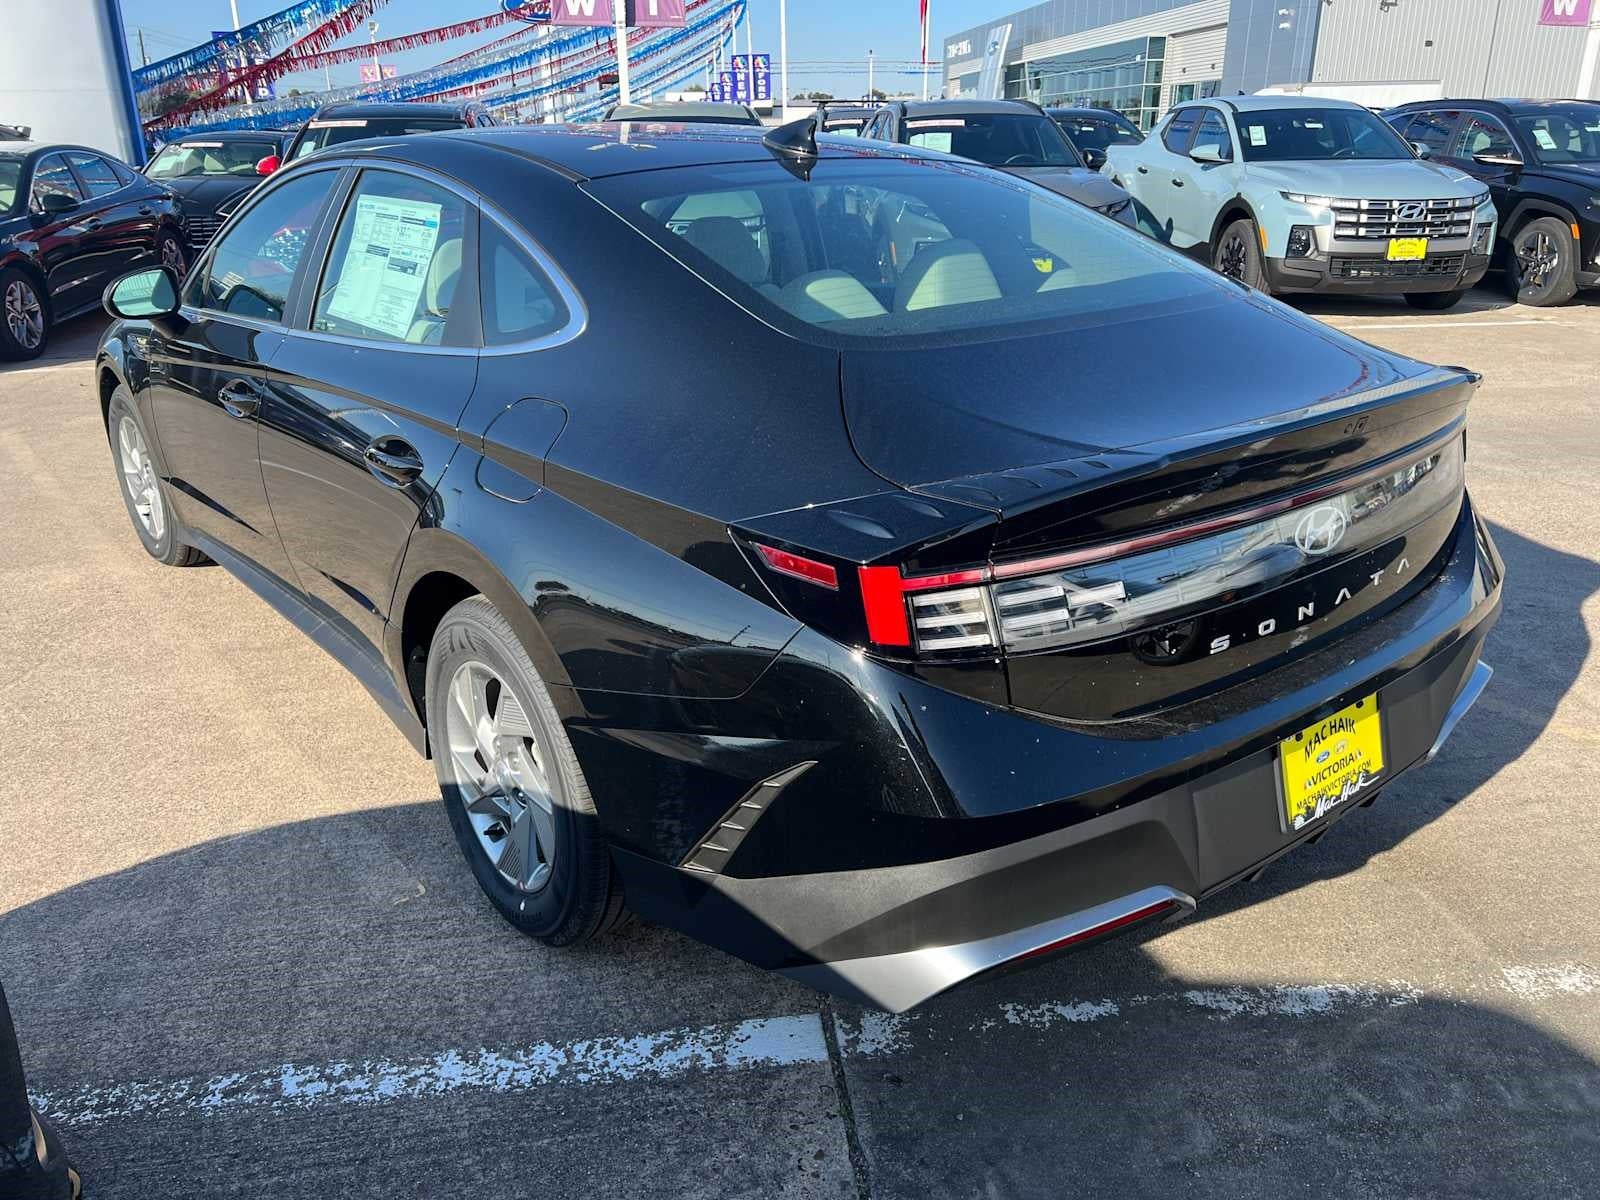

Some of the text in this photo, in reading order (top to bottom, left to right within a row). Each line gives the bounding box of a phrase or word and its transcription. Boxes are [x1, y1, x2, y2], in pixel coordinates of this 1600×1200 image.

[736, 72, 747, 99] NEW
[757, 72, 767, 100] FORD
[1209, 558, 1410, 655] SONATA
[1304, 724, 1328, 763] MAC
[1329, 717, 1356, 735] HAIK
[1311, 752, 1354, 786] VICTORIA
